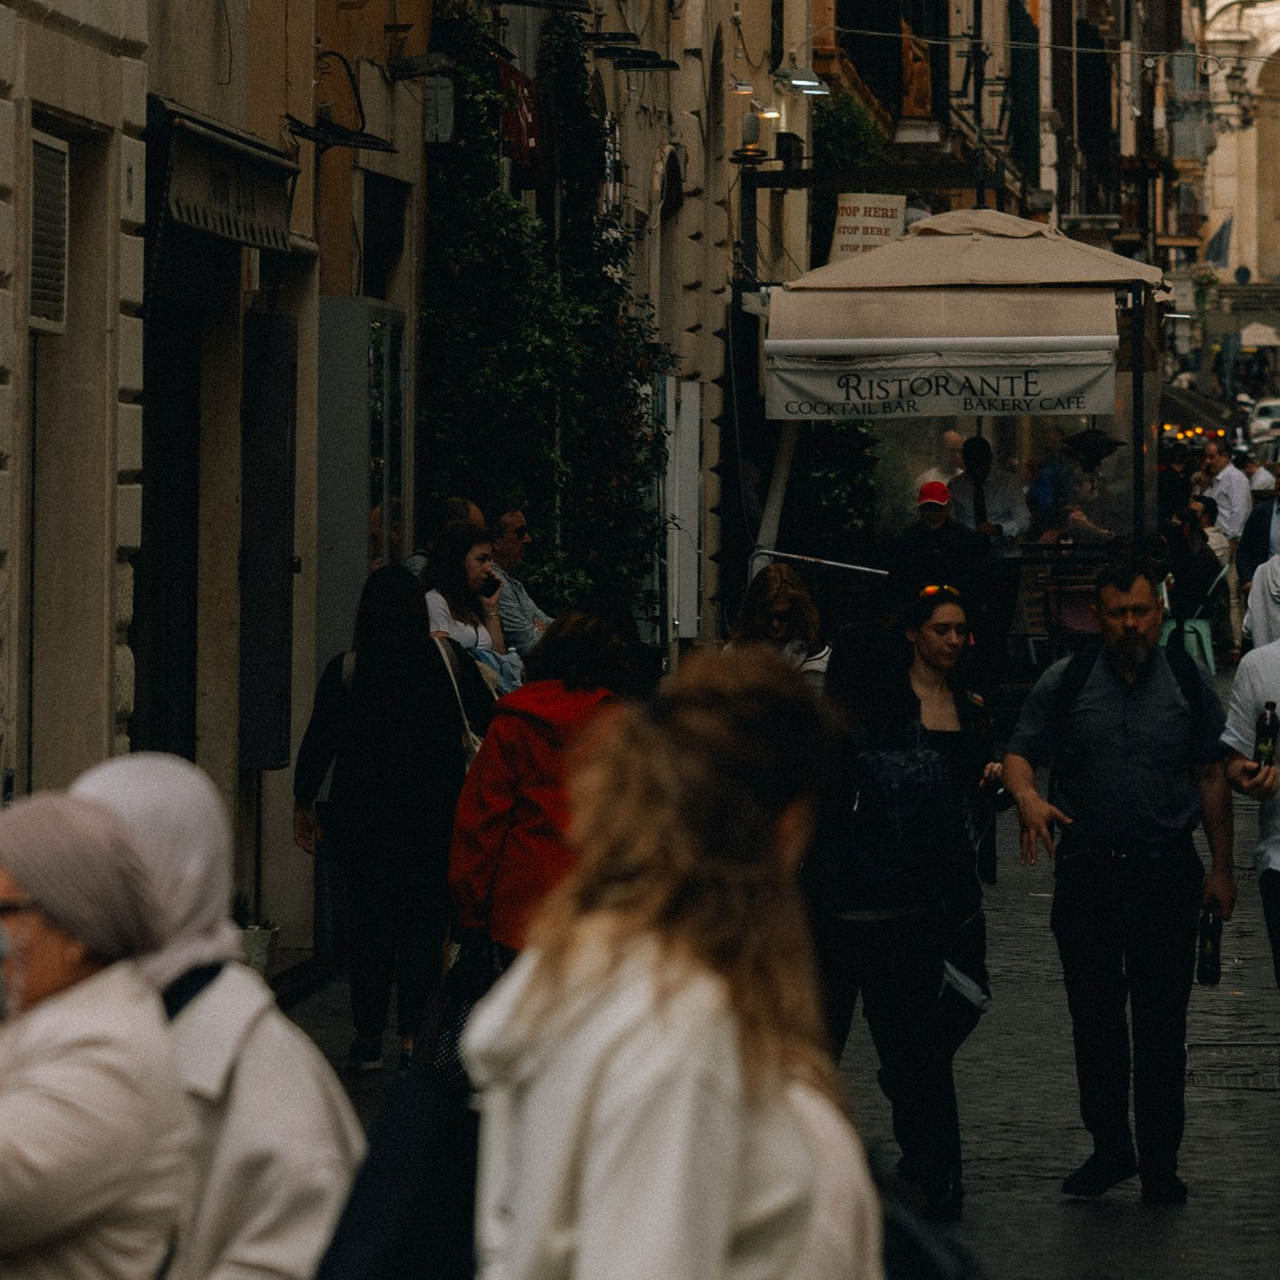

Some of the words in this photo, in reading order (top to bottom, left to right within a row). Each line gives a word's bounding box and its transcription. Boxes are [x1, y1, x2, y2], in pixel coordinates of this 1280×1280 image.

[863, 207, 898, 219] HERE
[837, 226, 860, 235] STOP
[862, 226, 891, 236] HERE
[837, 369, 1042, 401] RISTORANTE
[785, 400, 878, 416] COCKTAIL
[882, 399, 920, 414] BAR
[963, 397, 1034, 412] BAKERY
[1039, 391, 1086, 411] CAFÉ
